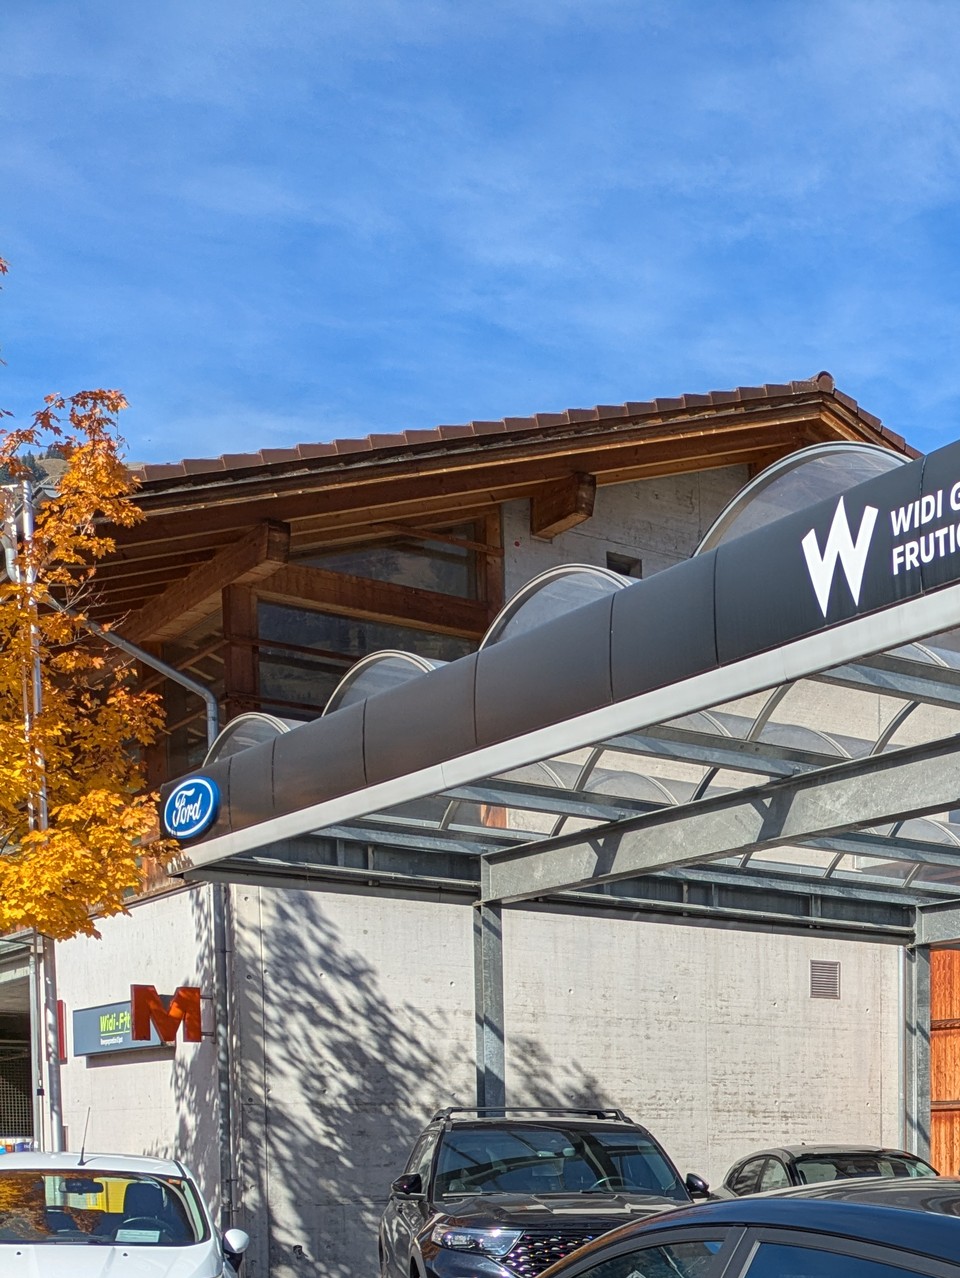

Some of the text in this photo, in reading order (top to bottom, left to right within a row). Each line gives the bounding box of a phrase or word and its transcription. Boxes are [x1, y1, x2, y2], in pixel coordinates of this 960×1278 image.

[890, 489, 943, 537] WIDI
[172, 787, 203, 828] Ford
[130, 984, 202, 1043] M
